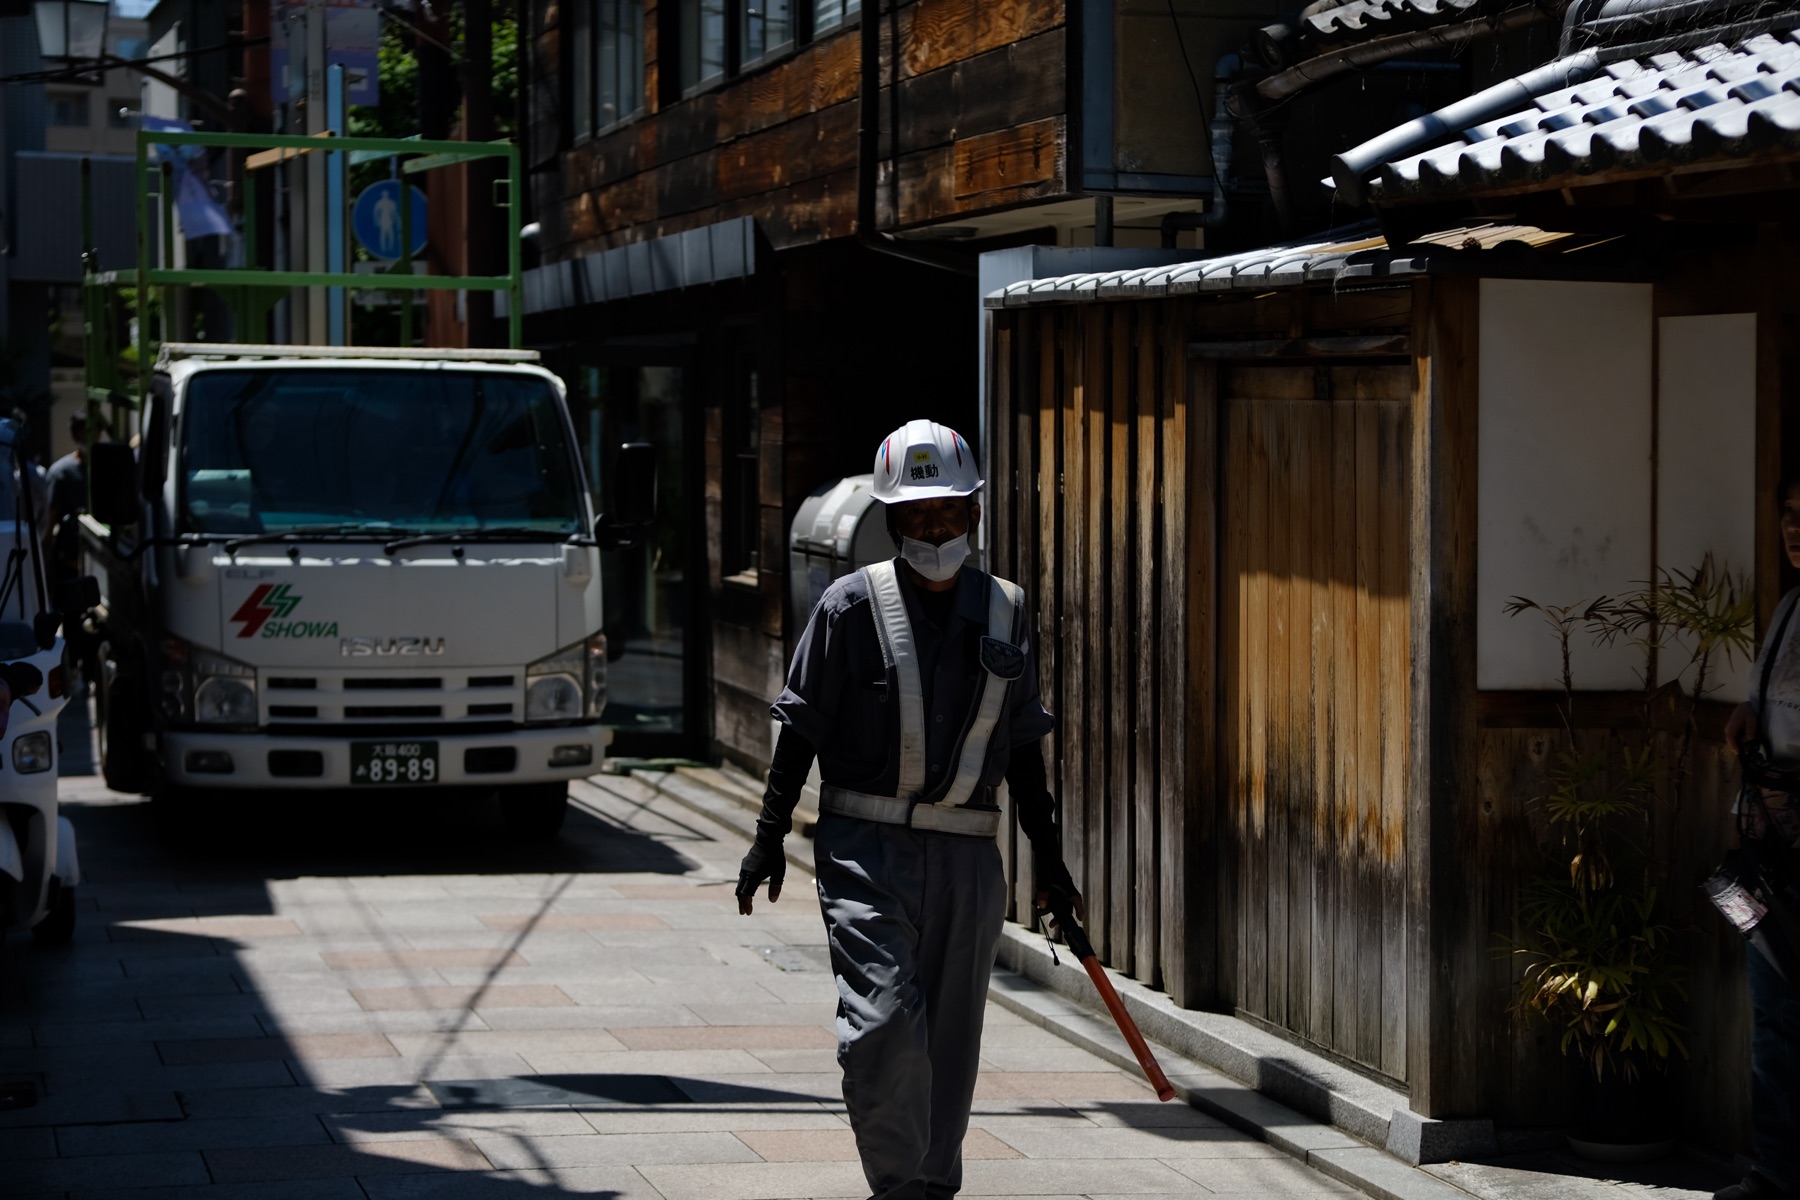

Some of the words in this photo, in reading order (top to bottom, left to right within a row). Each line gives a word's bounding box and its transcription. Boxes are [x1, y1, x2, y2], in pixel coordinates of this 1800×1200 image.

[910, 463, 939, 481] 機動
[261, 621, 339, 639] SHOWA
[340, 637, 445, 657] ISUZU
[369, 758, 436, 782] 89-89
